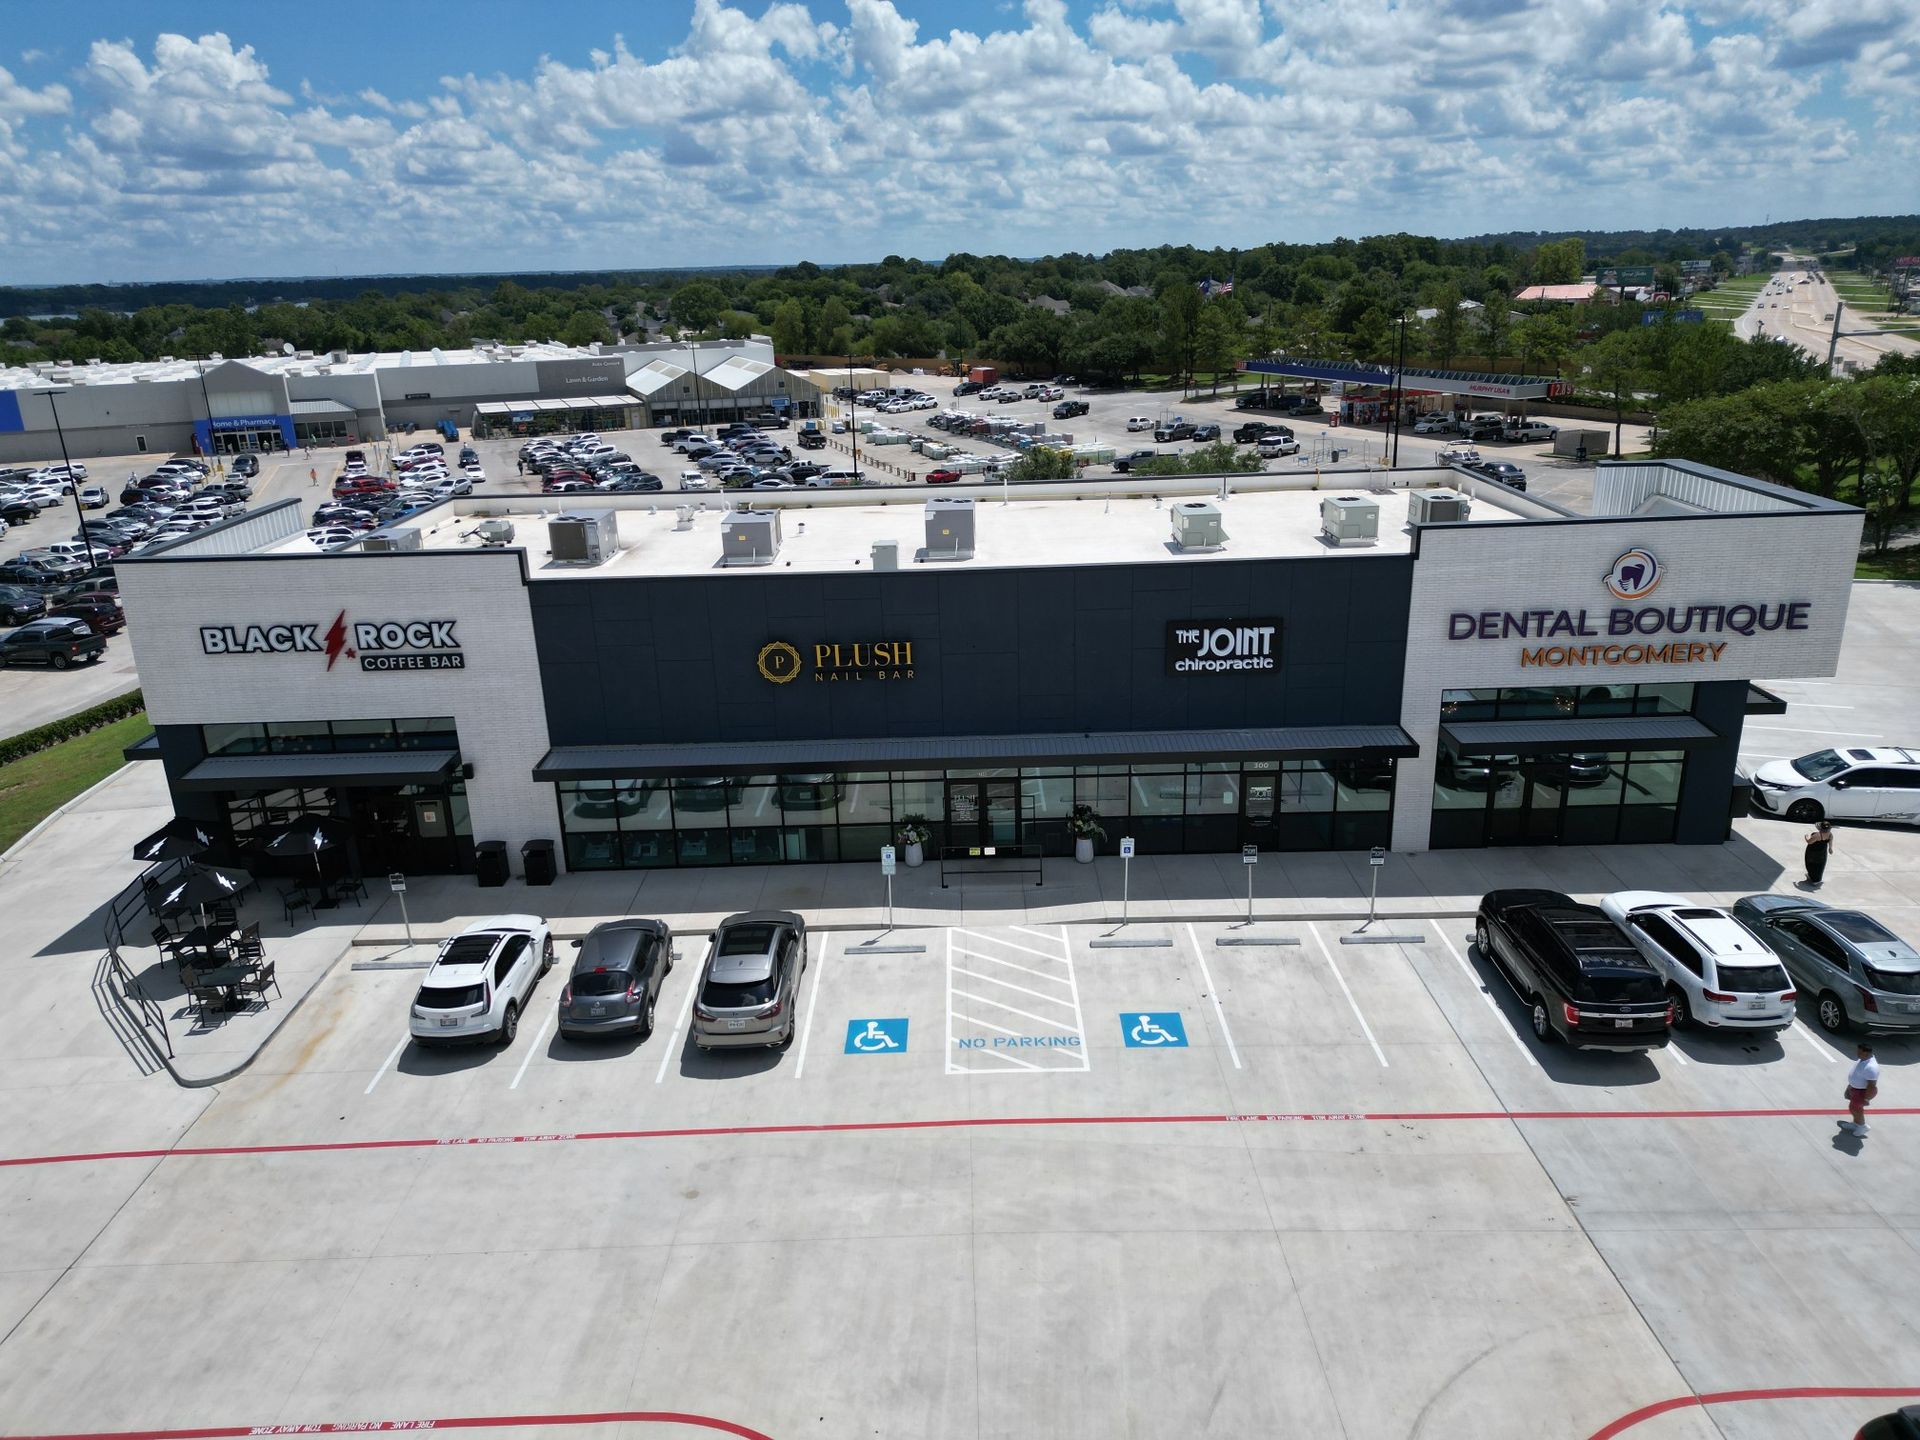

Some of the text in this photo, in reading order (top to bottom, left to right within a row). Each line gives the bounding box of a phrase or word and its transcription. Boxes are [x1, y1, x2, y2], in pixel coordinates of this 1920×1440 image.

[1448, 602, 1811, 640] DENTAL BOUTIQUE
[200, 620, 460, 654] BLACK ROCK
[1175, 627, 1275, 657] THE JOINT
[774, 655, 785, 669] P
[813, 642, 913, 668] PLUSH
[1521, 641, 1728, 668] MONTGOMERY
[364, 655, 461, 670] COFFEE BAR
[1175, 657, 1274, 672] chiropractic
[815, 671, 914, 682] NAIL BAR
[959, 1035, 1081, 1049] NO PARKING
[248, 1421, 436, 1436] FIRE LANE NO PARKING TOW AWAY ZONE
